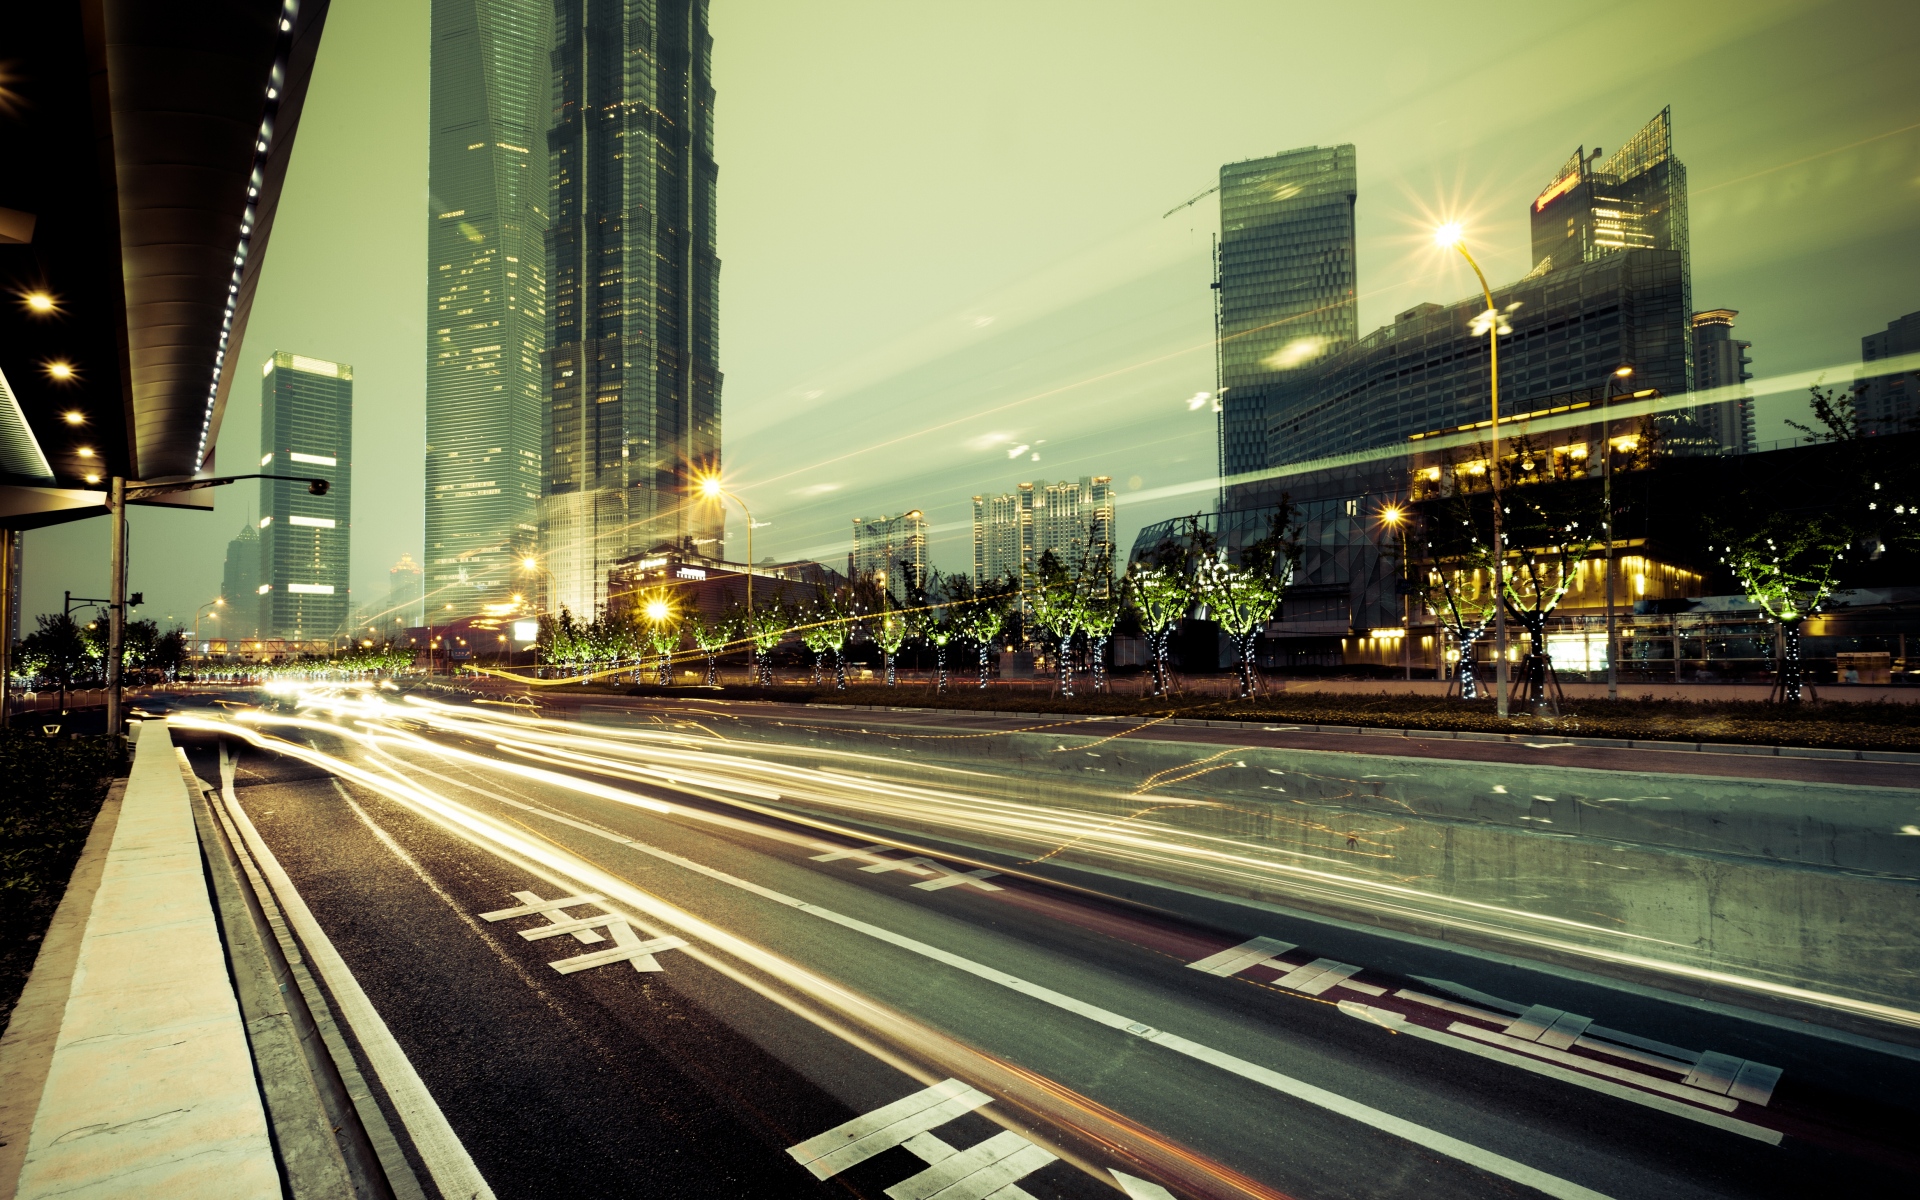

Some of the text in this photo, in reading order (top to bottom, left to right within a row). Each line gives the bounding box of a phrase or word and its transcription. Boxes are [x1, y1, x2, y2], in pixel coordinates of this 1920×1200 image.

[808, 842, 1004, 891] 车
[478, 891, 690, 975] 车
[1185, 936, 1784, 1146] 型
